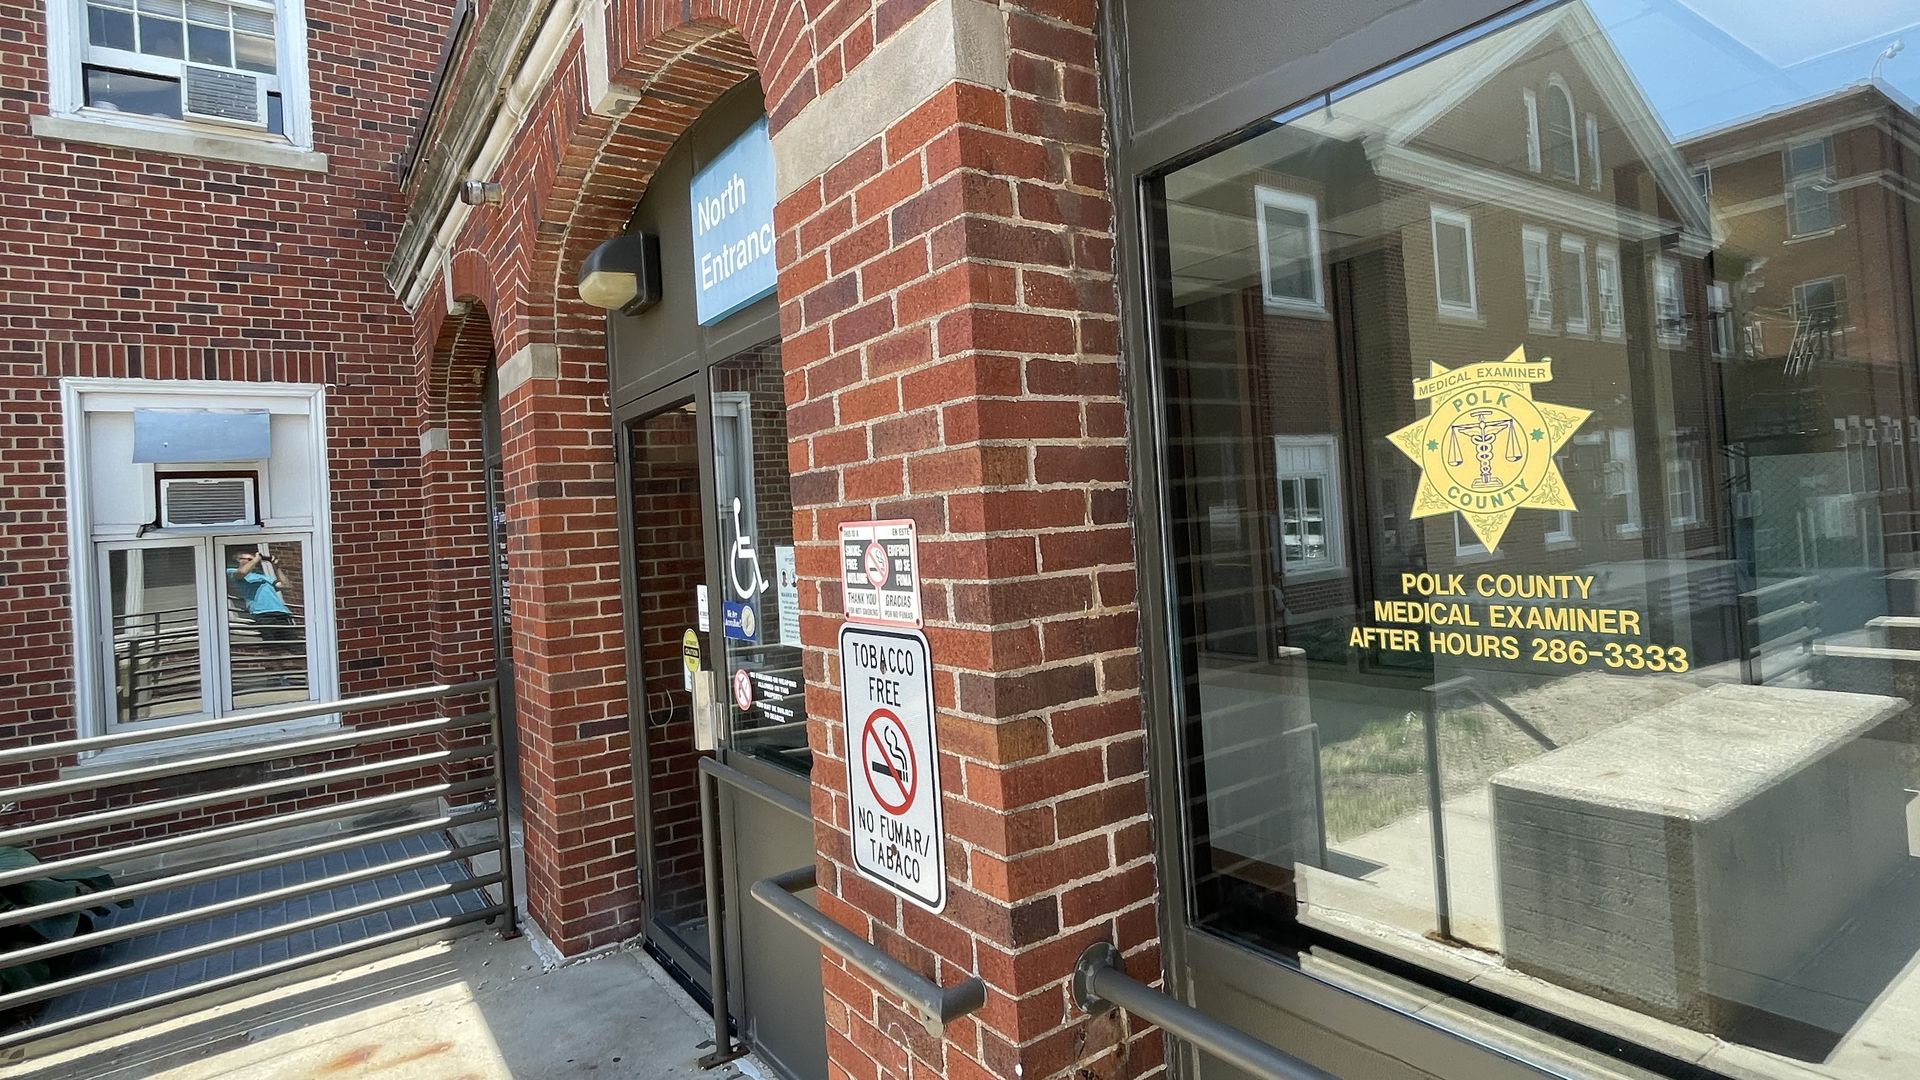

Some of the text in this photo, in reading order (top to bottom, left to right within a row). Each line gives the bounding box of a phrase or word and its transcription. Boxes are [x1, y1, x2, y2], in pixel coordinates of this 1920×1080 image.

[698, 172, 746, 236] North
[701, 221, 775, 292] Entranc
[1418, 368, 1546, 396] MEDICAL EXAMINER
[1452, 390, 1511, 412] POLK
[1448, 478, 1530, 509] COUNTY
[899, 528, 910, 536] ESTE
[846, 559, 858, 570] FREE
[895, 559, 911, 572] NO SE
[896, 574, 912, 586] FUMA
[1401, 573, 1594, 600] POLK COUNTY
[848, 592, 877, 605] THANK YOU
[886, 594, 911, 608] GRACIAS
[1374, 601, 1640, 635] MEDICAL EXAMINER
[853, 642, 914, 676] TOBACCO
[1349, 626, 1690, 674] AFTER HOURS 286-3333
[869, 676, 901, 707] FREE
[858, 806, 930, 857] NO FUMAR/
[870, 839, 920, 883] TABACO
